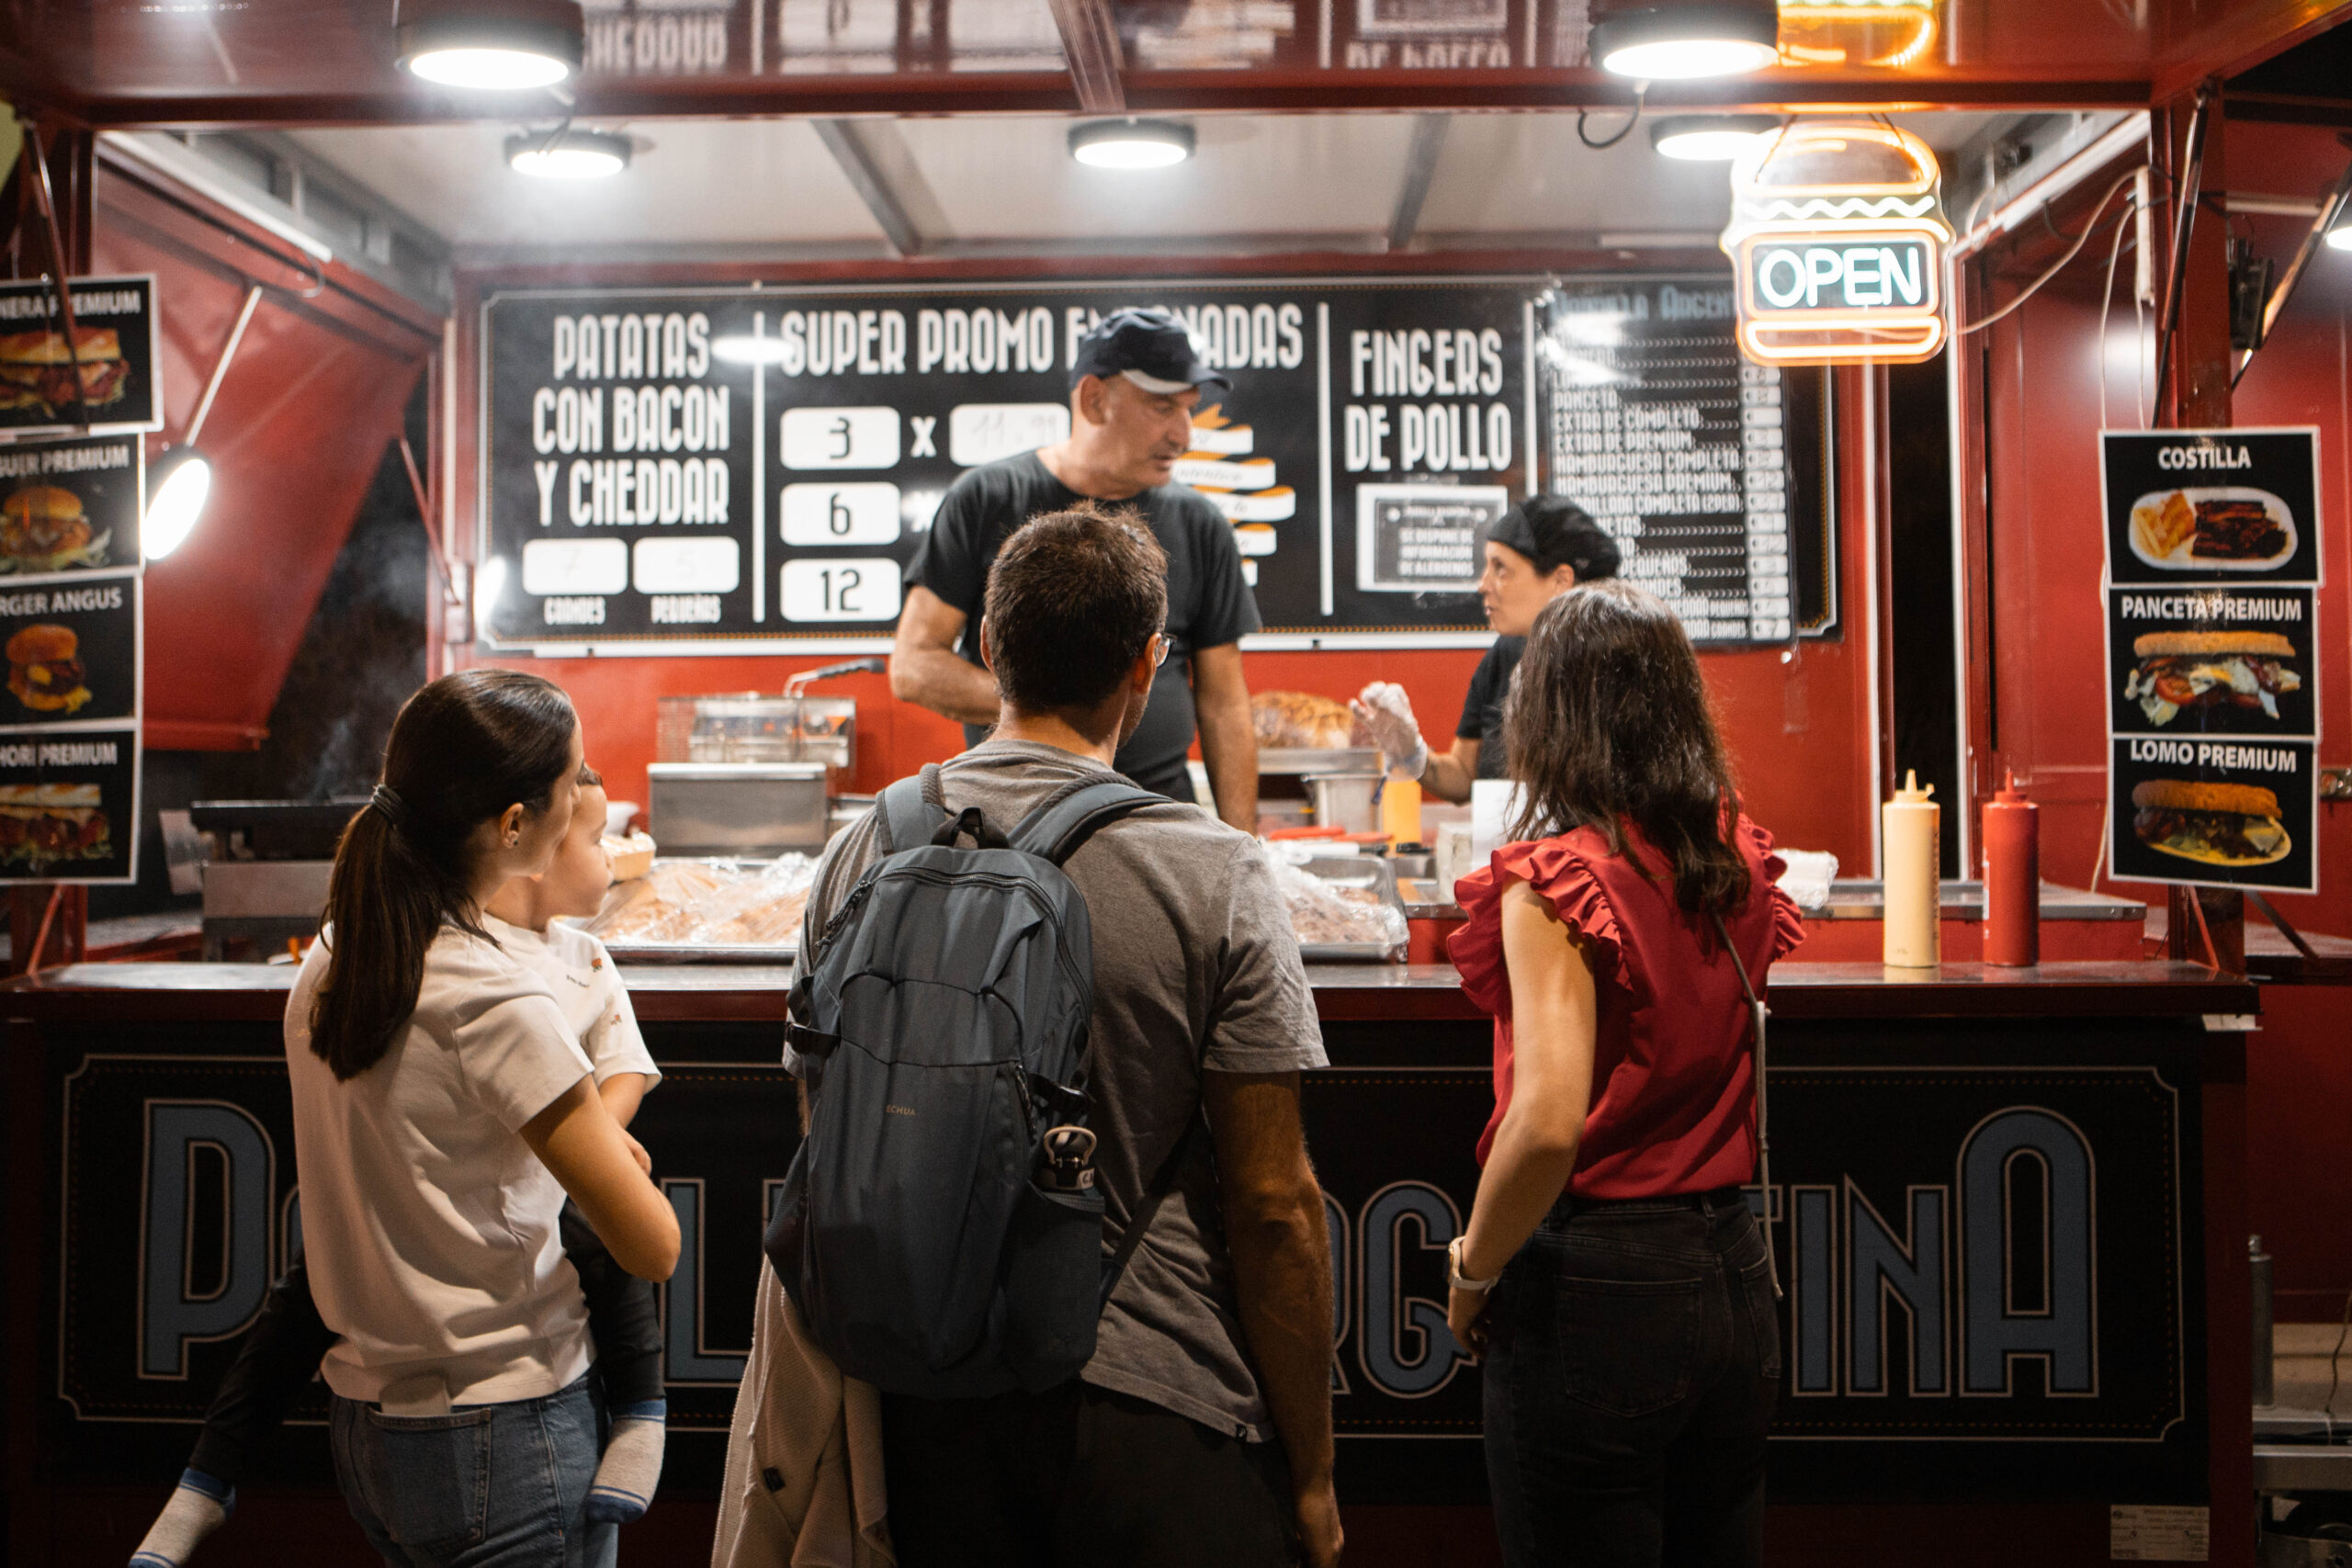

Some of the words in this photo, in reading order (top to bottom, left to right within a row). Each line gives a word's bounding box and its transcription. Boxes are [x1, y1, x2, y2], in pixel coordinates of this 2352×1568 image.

[1758, 246, 1921, 308] OPEN
[48, 290, 141, 317] PEMIUM
[553, 312, 710, 380] PATATAS
[780, 310, 906, 376] SUPER
[918, 307, 1054, 374] PROMO
[1351, 328, 1502, 398] FINGERS
[533, 387, 604, 455] CON
[613, 385, 730, 452] BACON
[830, 417, 851, 458] 3
[1345, 405, 1390, 471] DE
[1400, 402, 1512, 471] POLLO
[42, 444, 130, 472] PREMIUM
[2158, 446, 2252, 469] COSTILLA
[534, 460, 559, 526] Y
[569, 457, 729, 527] CHEDDAR
[831, 493, 851, 534] 6
[51, 586, 122, 613] ANGUS
[821, 570, 860, 612] 12
[2121, 595, 2207, 620] PANCETA
[2212, 597, 2301, 621] PREMIUM
[39, 742, 118, 766] PREMIUM
[2130, 739, 2194, 765] LOMO
[2198, 743, 2297, 773] PREMIUM
